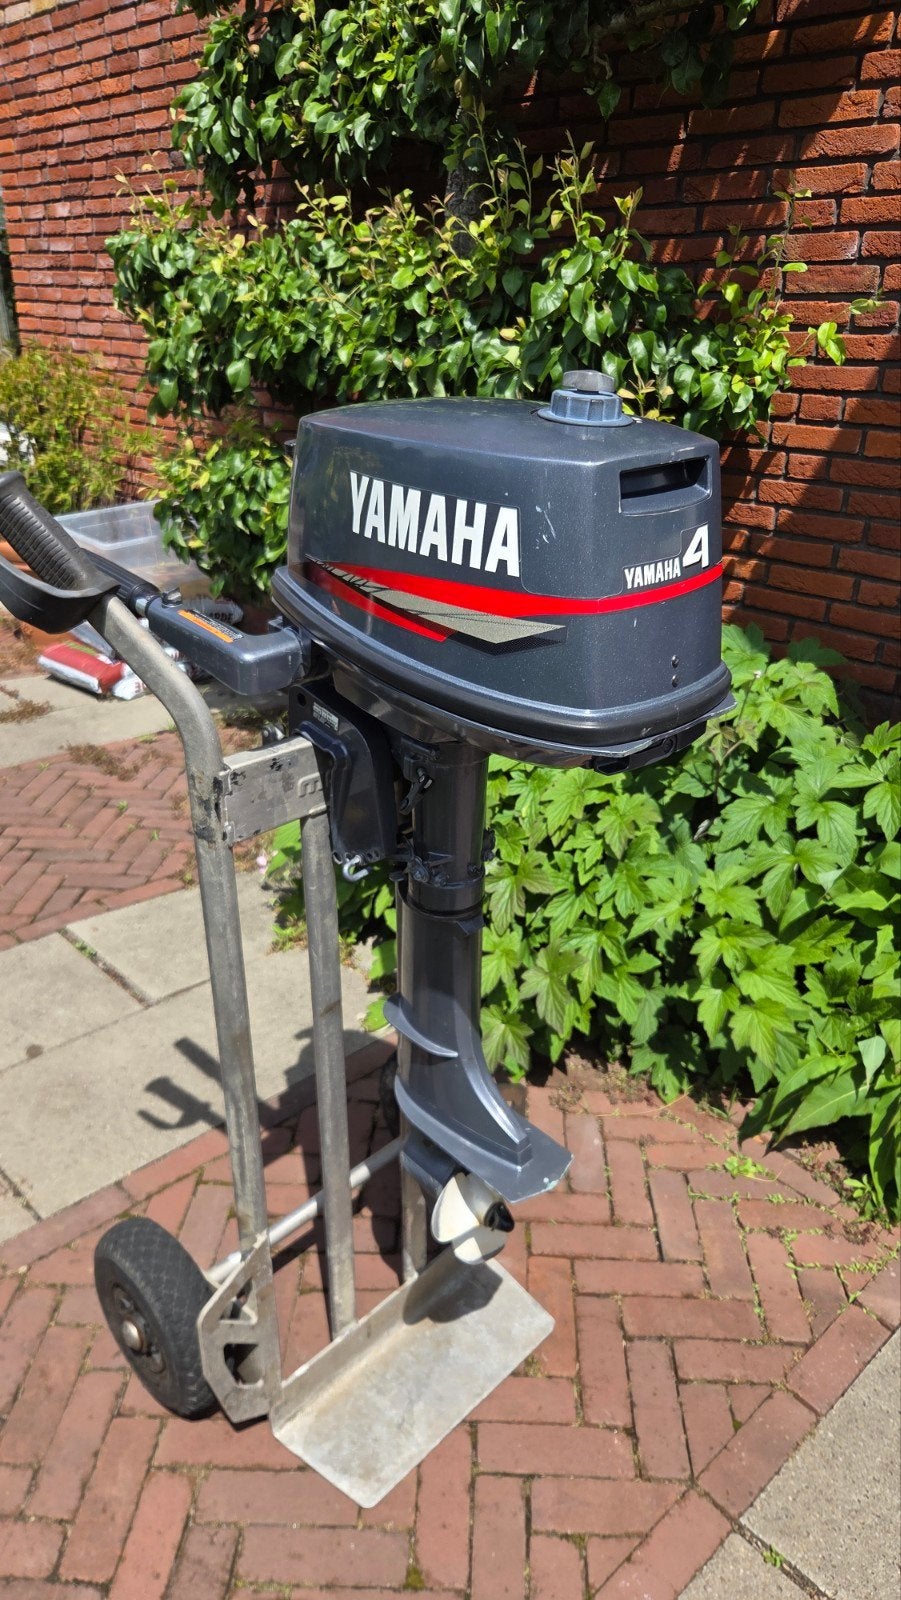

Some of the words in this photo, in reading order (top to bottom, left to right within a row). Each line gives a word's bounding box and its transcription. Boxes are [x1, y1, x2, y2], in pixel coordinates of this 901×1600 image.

[349, 471, 520, 578] YAMAHA
[624, 556, 682, 590] YAMAHA
[682, 523, 709, 568] 4
